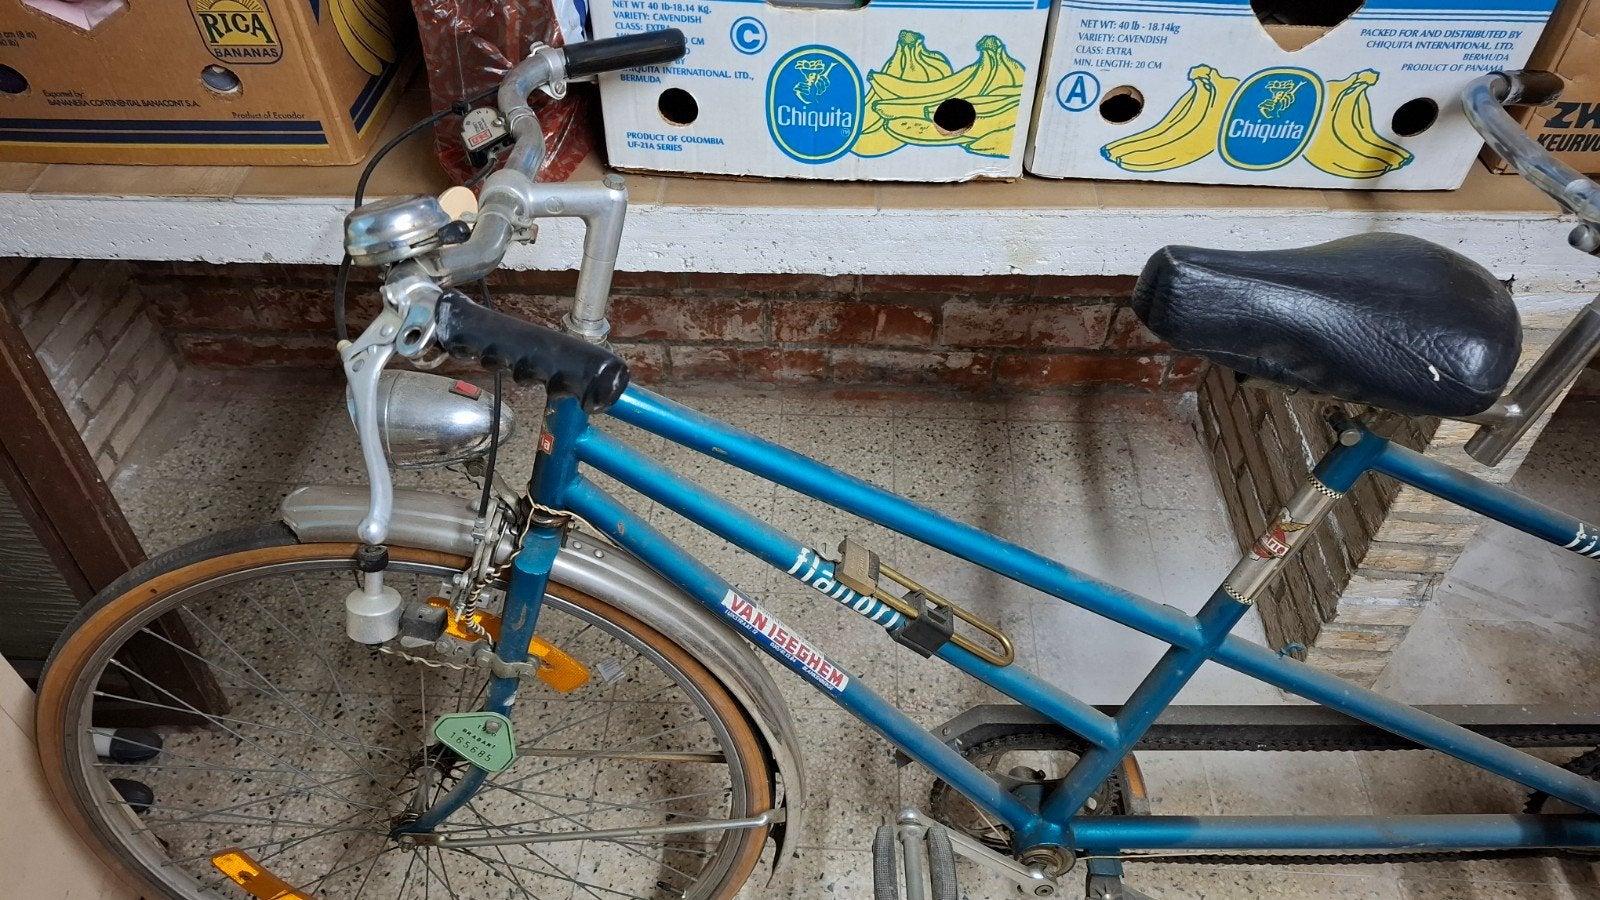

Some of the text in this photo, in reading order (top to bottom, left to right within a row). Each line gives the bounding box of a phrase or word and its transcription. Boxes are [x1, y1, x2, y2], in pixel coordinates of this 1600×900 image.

[613, 1, 628, 9] NET
[632, 1, 645, 10] WT
[648, 2, 658, 11] 40
[613, 11, 702, 24] VARIETY: CAVENDISH
[198, 13, 276, 44] RICA
[615, 21, 643, 31] CLASS:
[1080, 19, 1099, 29] NET
[1100, 20, 1116, 30] WT:
[1119, 21, 1129, 30] 40
[1131, 20, 1140, 30] lb
[1148, 22, 1180, 35] 18.14kg
[1078, 31, 1168, 44] VARIETY: CAVENDISH
[1360, 28, 1523, 39] PACKED FOR AND DISTRIBUTED BY
[691, 37, 705, 46] CM
[1366, 40, 1413, 50] CHIQUITA
[1494, 42, 1514, 51] LTD.
[214, 47, 279, 58] BANANAS
[1075, 45, 1132, 56] CLASS: EXTRA
[1462, 53, 1510, 61] BERMUDA
[1073, 58, 1162, 69] MIN. LENGTH: 20 CM
[1400, 63, 1504, 73] PRODUCT OF PANAMA
[622, 64, 660, 75] QUITA
[620, 73, 661, 84] BERMUDA
[1065, 75, 1087, 105] A
[231, 110, 305, 120] Product of Ecuador
[777, 105, 852, 131] Chiquita
[1228, 118, 1305, 144] Chiquita
[626, 131, 665, 141] PRODUCT
[680, 135, 724, 145] COLOMBIA
[627, 141, 682, 152] UF-21A SERIES
[731, 594, 769, 631] VAN
[767, 623, 845, 688] ISEGHEM
[448, 731, 494, 762] 165685
